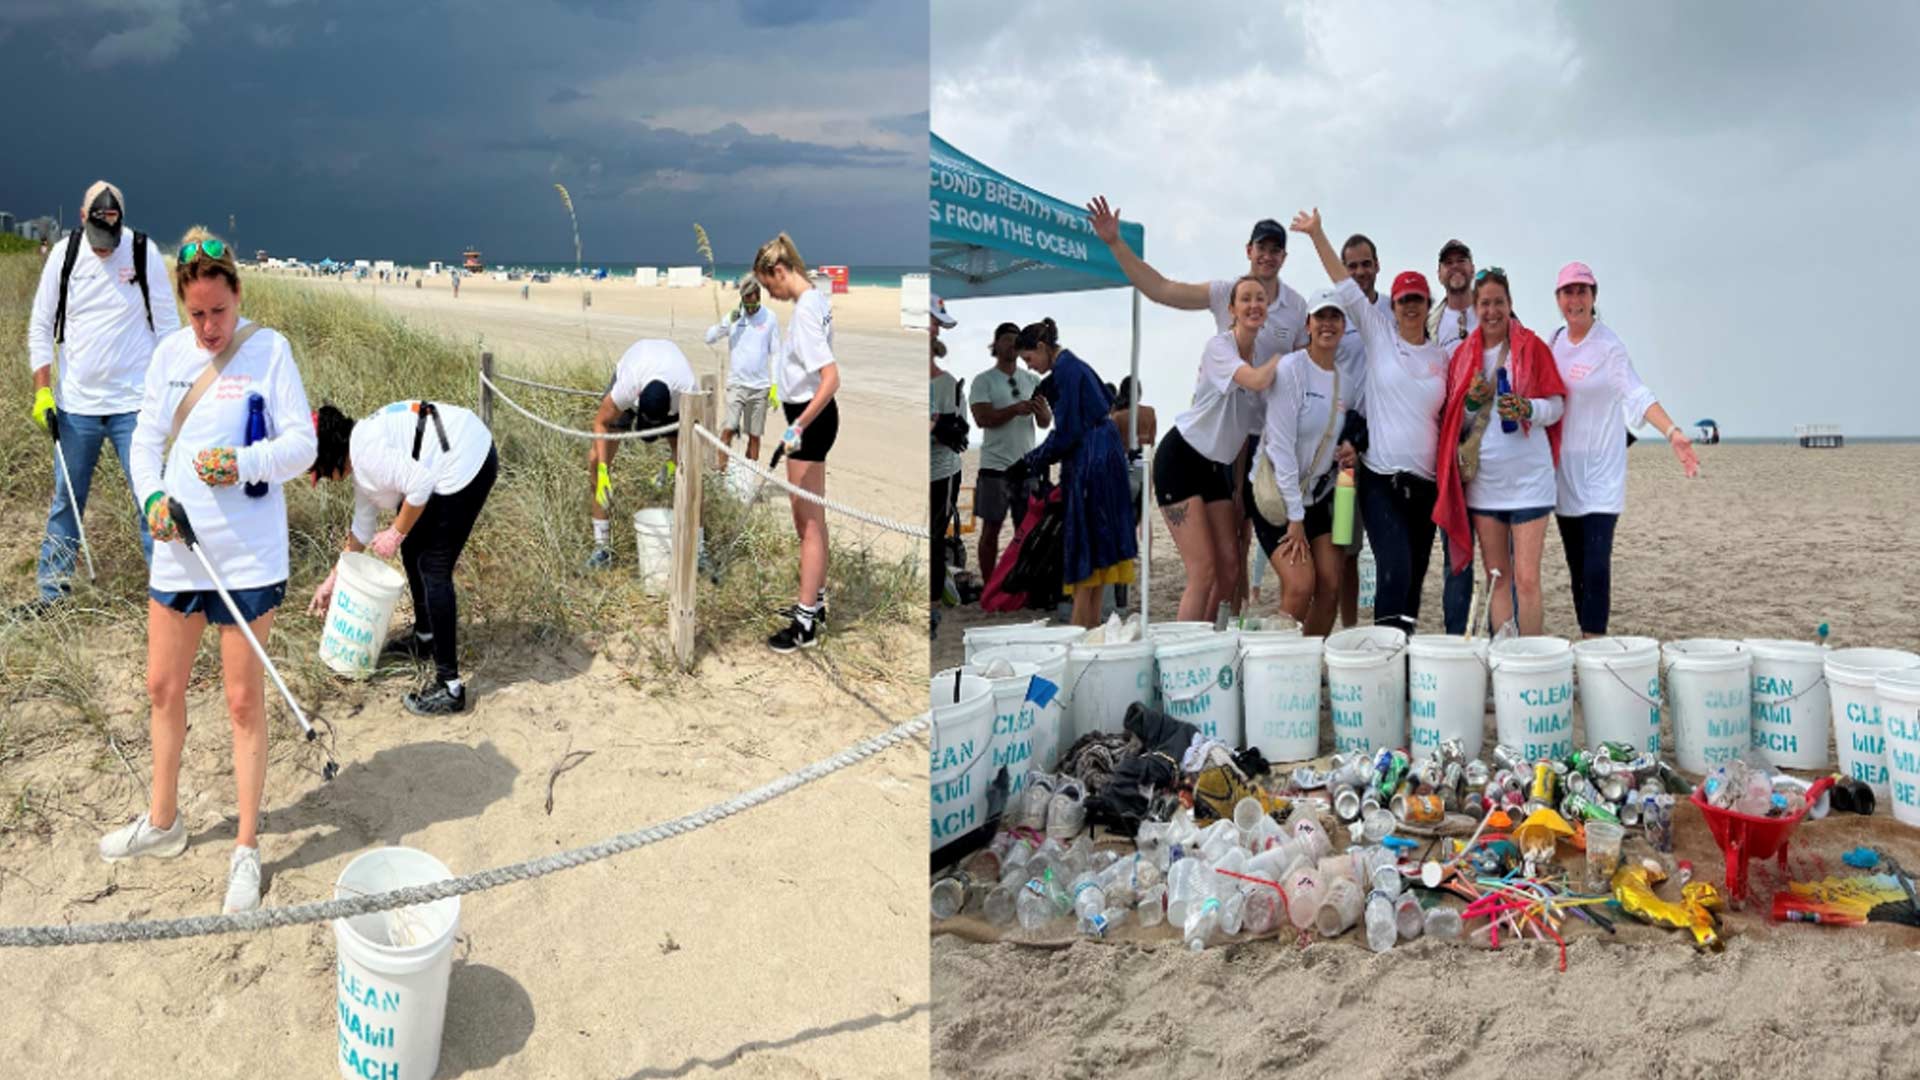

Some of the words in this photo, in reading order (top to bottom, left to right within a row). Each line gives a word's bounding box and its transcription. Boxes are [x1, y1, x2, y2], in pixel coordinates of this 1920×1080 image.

[986, 181, 1051, 221] BREATH
[1053, 208, 1078, 230] WE
[946, 204, 999, 236] FROM
[1001, 218, 1035, 247] THE
[1037, 229, 1088, 262] OCEAN
